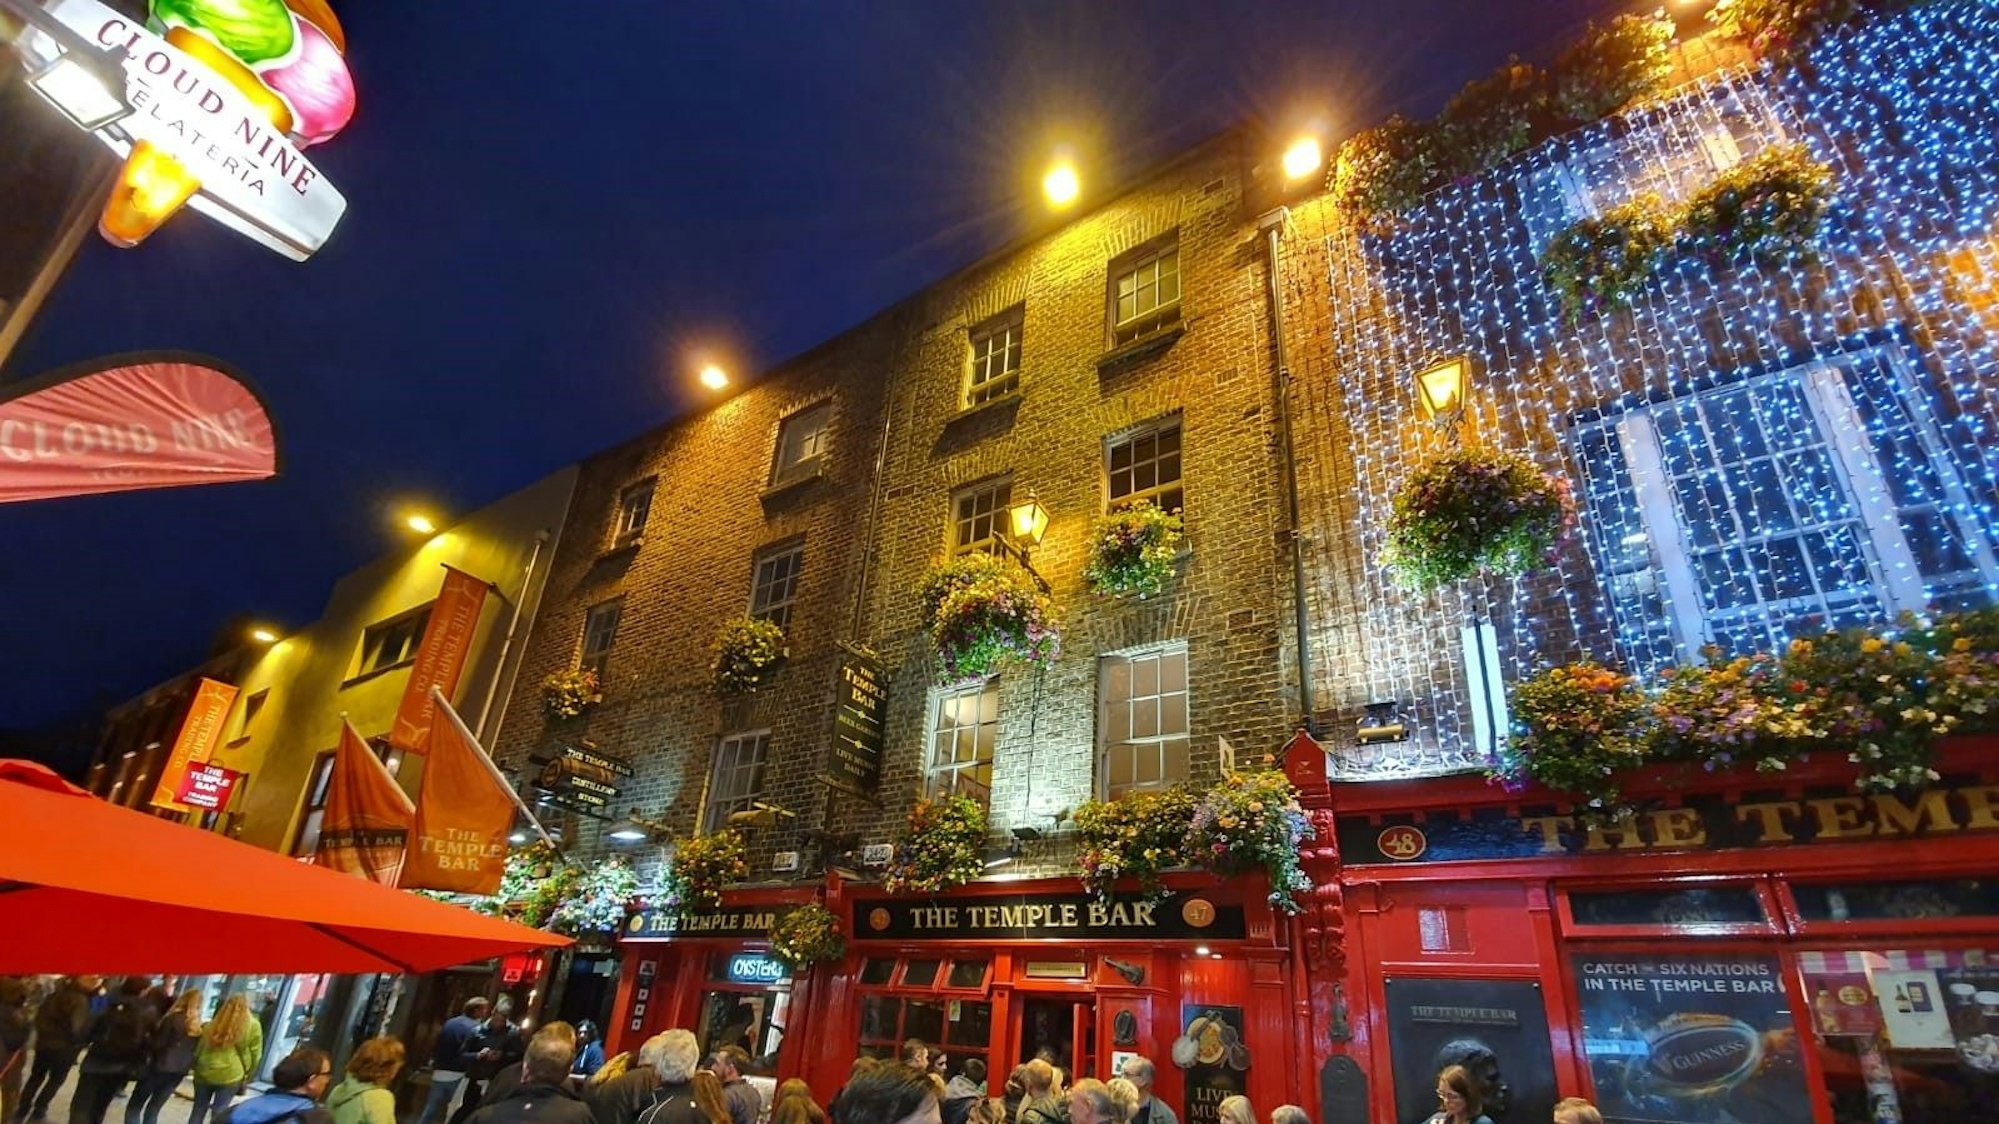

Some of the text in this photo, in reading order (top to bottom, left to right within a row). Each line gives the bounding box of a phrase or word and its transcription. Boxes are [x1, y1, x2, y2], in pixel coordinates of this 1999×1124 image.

[97, 19, 316, 196] CLOUD NINE
[126, 82, 266, 196] ELATERIA
[451, 605, 470, 632] THE
[432, 632, 460, 688] TEMPLE
[860, 666, 875, 680] THE
[843, 666, 887, 700] TEMPLE
[852, 687, 875, 710] BAR
[567, 748, 584, 760] THE
[191, 770, 230, 788] TEMPLE
[204, 766, 224, 777] THE
[195, 781, 217, 792] BAR
[446, 827, 480, 842] THE
[1520, 807, 1706, 851] THE
[419, 836, 502, 858] TEMPLE
[1385, 833, 1416, 854] 48
[438, 855, 480, 871] BAR
[650, 912, 776, 931] THE TEMPLE BAR
[910, 901, 1158, 929] THE TEMPLE BAR
[1188, 906, 1208, 921] 47
[1583, 963, 1637, 975] CATCH
[1659, 963, 1688, 975] SIX
[1690, 964, 1769, 976] NATIONS
[1584, 978, 1775, 993] IN THE TEMPLE BAR
[1410, 1006, 1517, 1019] THE TEMPLE BAR
[1673, 1040, 1746, 1070] GUINNESS
[1191, 1103, 1220, 1119] MUS
